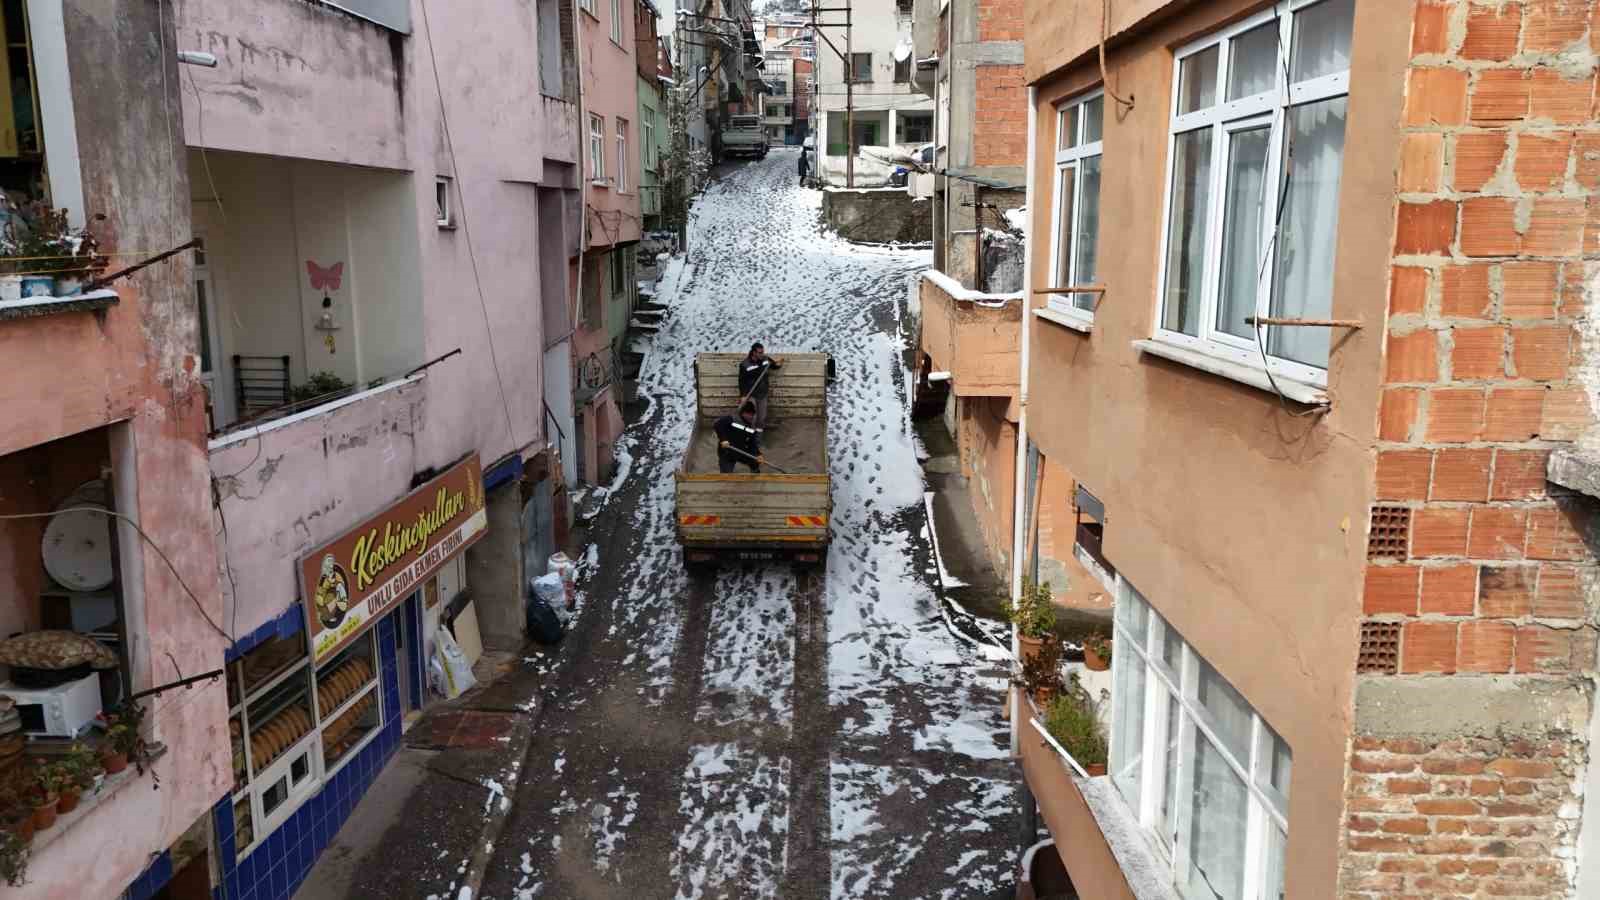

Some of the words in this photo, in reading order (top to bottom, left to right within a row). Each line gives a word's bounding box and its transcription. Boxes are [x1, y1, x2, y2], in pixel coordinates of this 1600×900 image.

[367, 584, 391, 614] UNLU
[393, 568, 414, 595] GIDA
[414, 545, 441, 578] EKMEK
[441, 528, 463, 556] FIRINI
